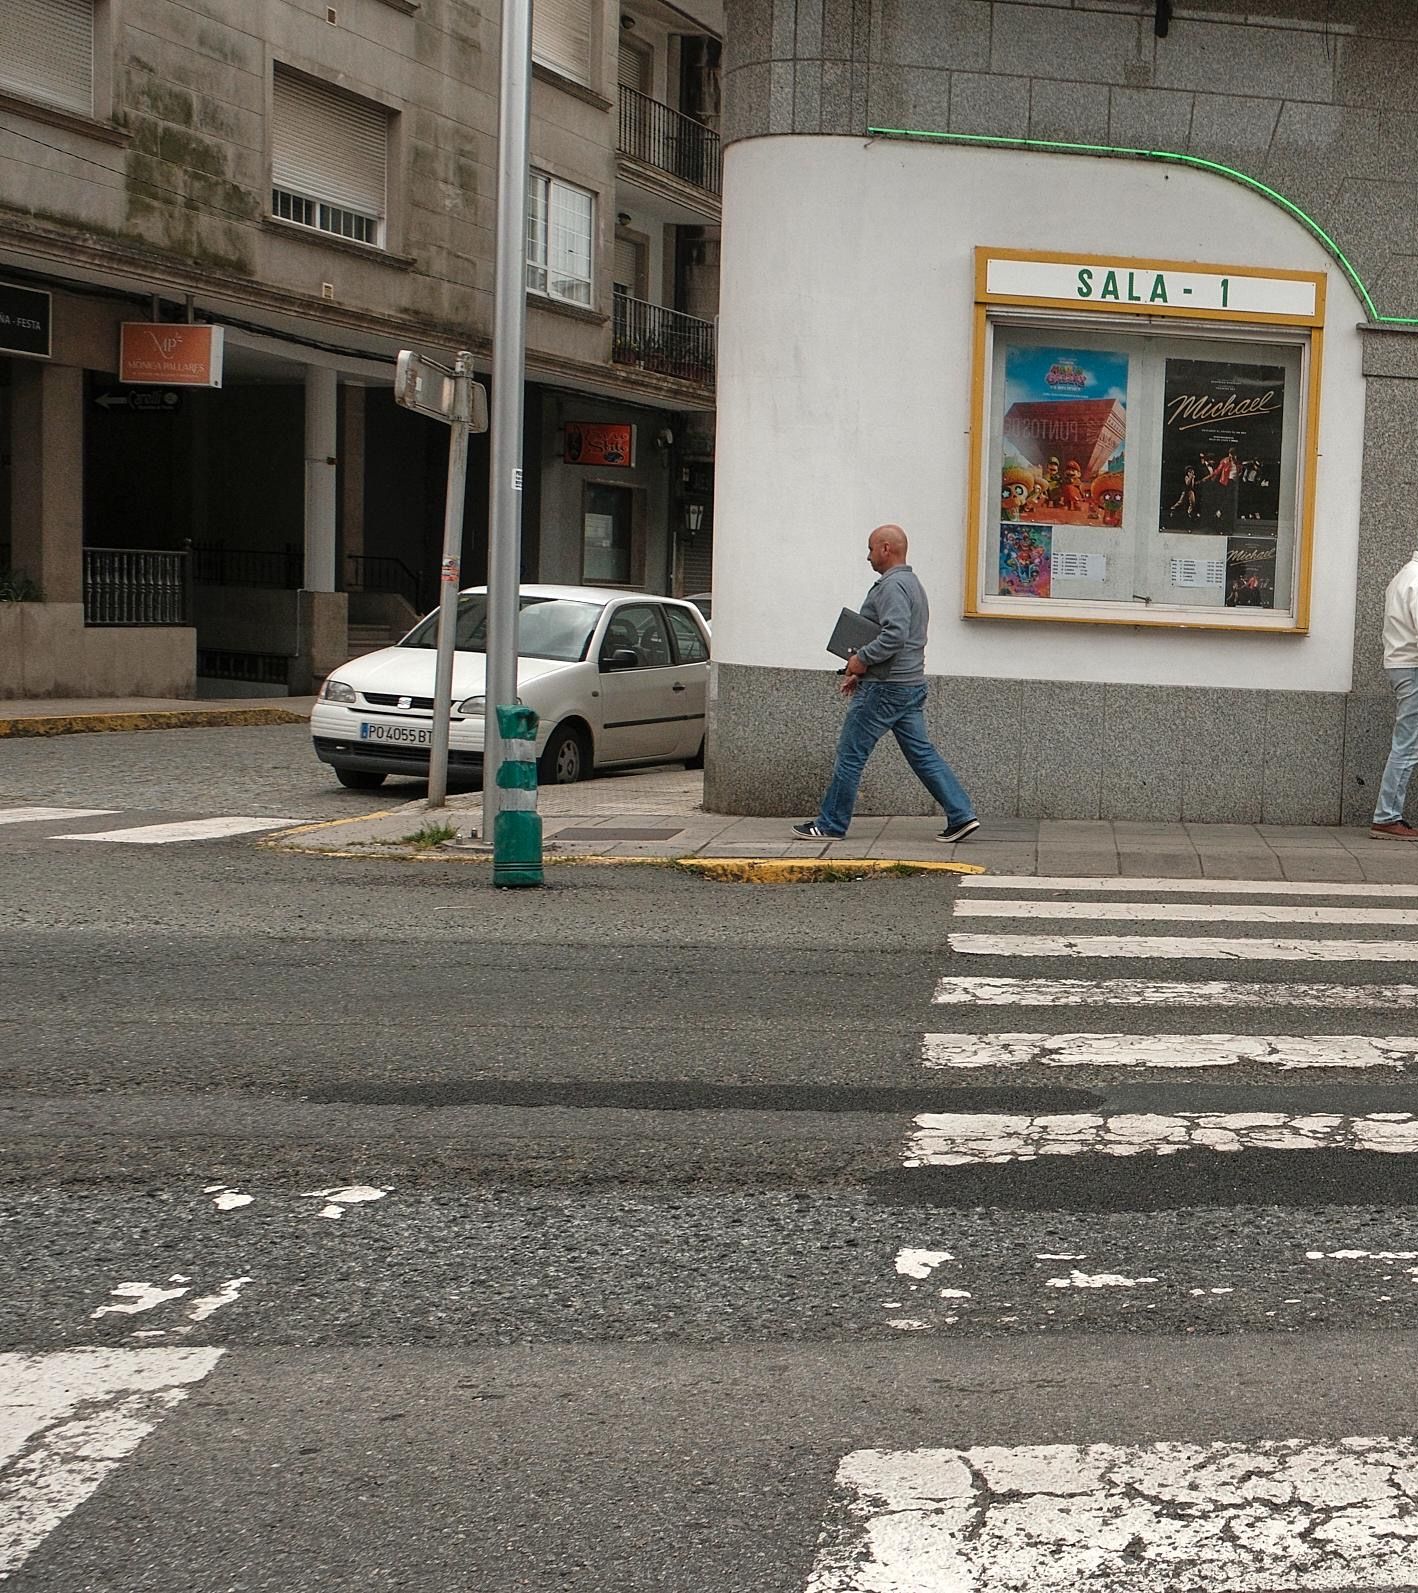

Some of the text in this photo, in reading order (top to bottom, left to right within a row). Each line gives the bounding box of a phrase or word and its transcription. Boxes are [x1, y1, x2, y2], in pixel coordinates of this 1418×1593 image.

[1077, 268, 1168, 303] SALA
[1220, 278, 1229, 307] 1
[17, 317, 41, 330] FESTA
[1167, 390, 1281, 425] Michael
[368, 725, 433, 743] PO 4055 BT
